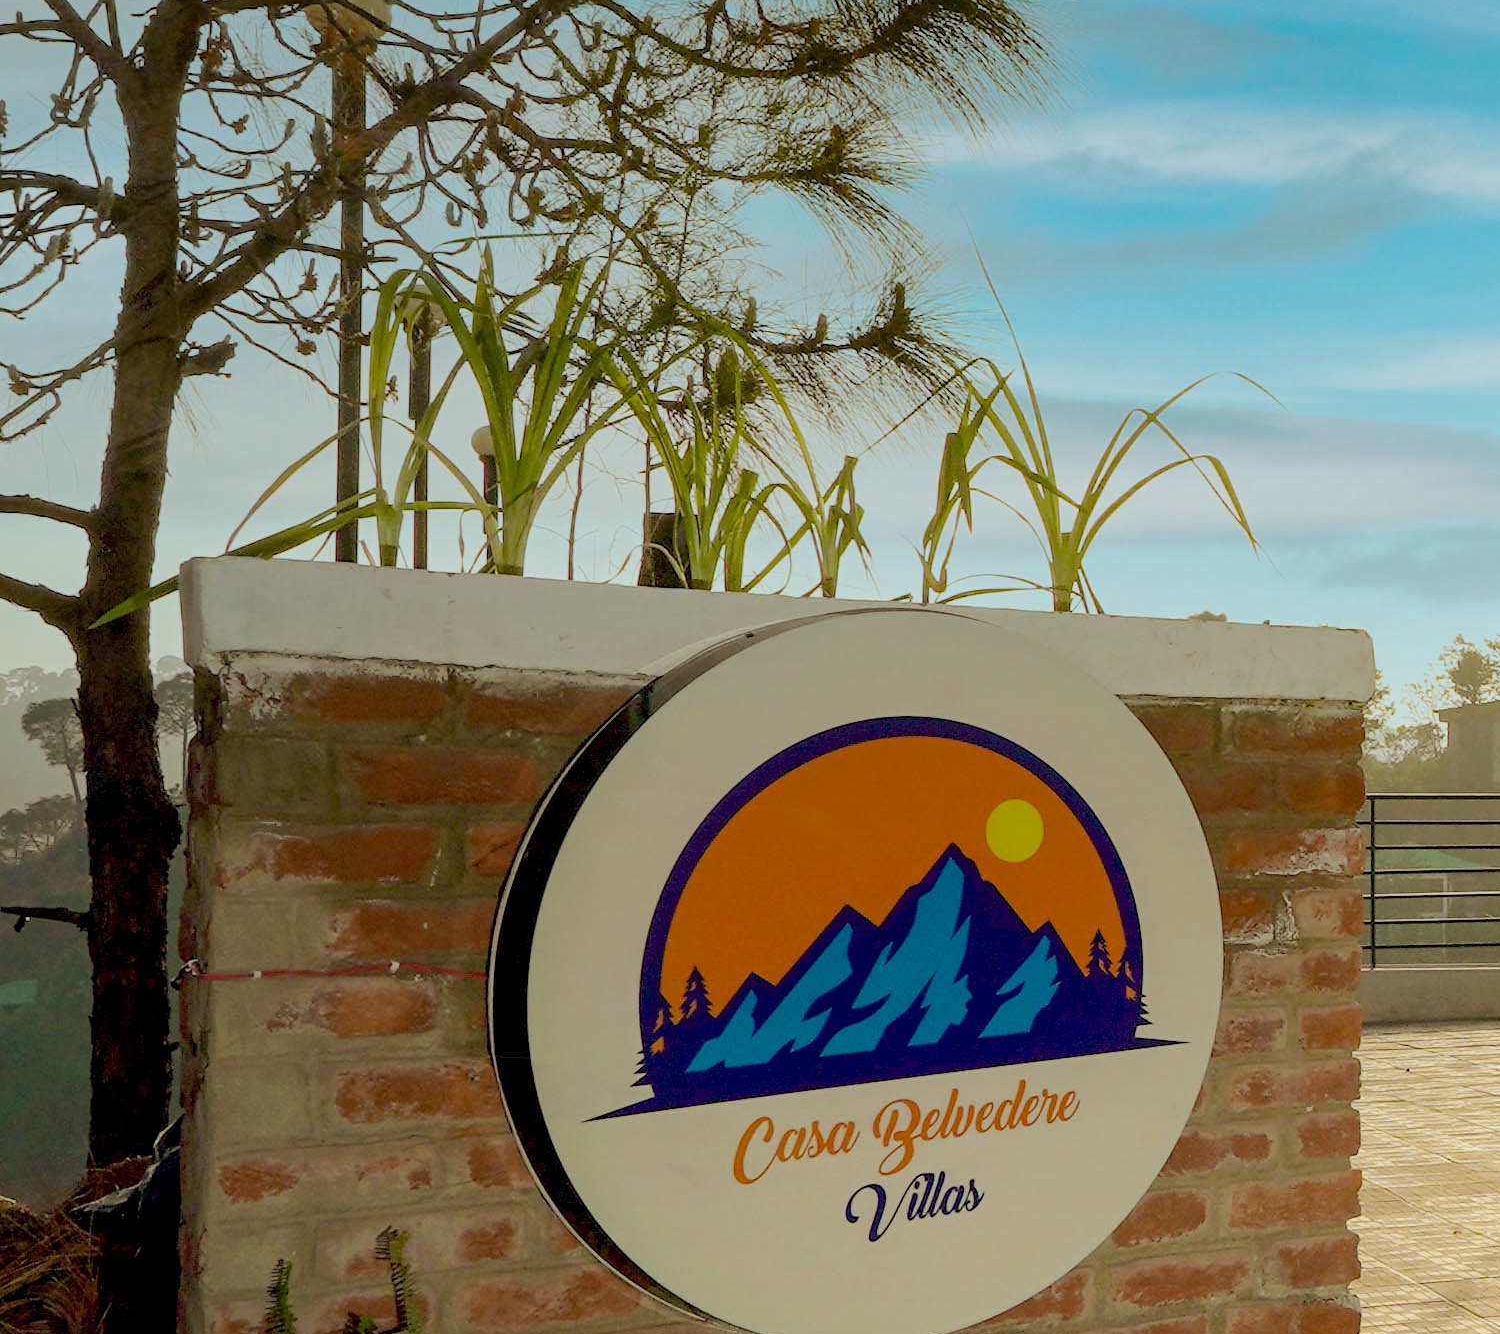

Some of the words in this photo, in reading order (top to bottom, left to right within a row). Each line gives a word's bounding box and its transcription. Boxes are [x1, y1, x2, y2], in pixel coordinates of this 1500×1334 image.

[733, 1114, 858, 1185] Casa
[873, 1079, 1079, 1176] Belvedere
[845, 1170, 984, 1243] Villas
